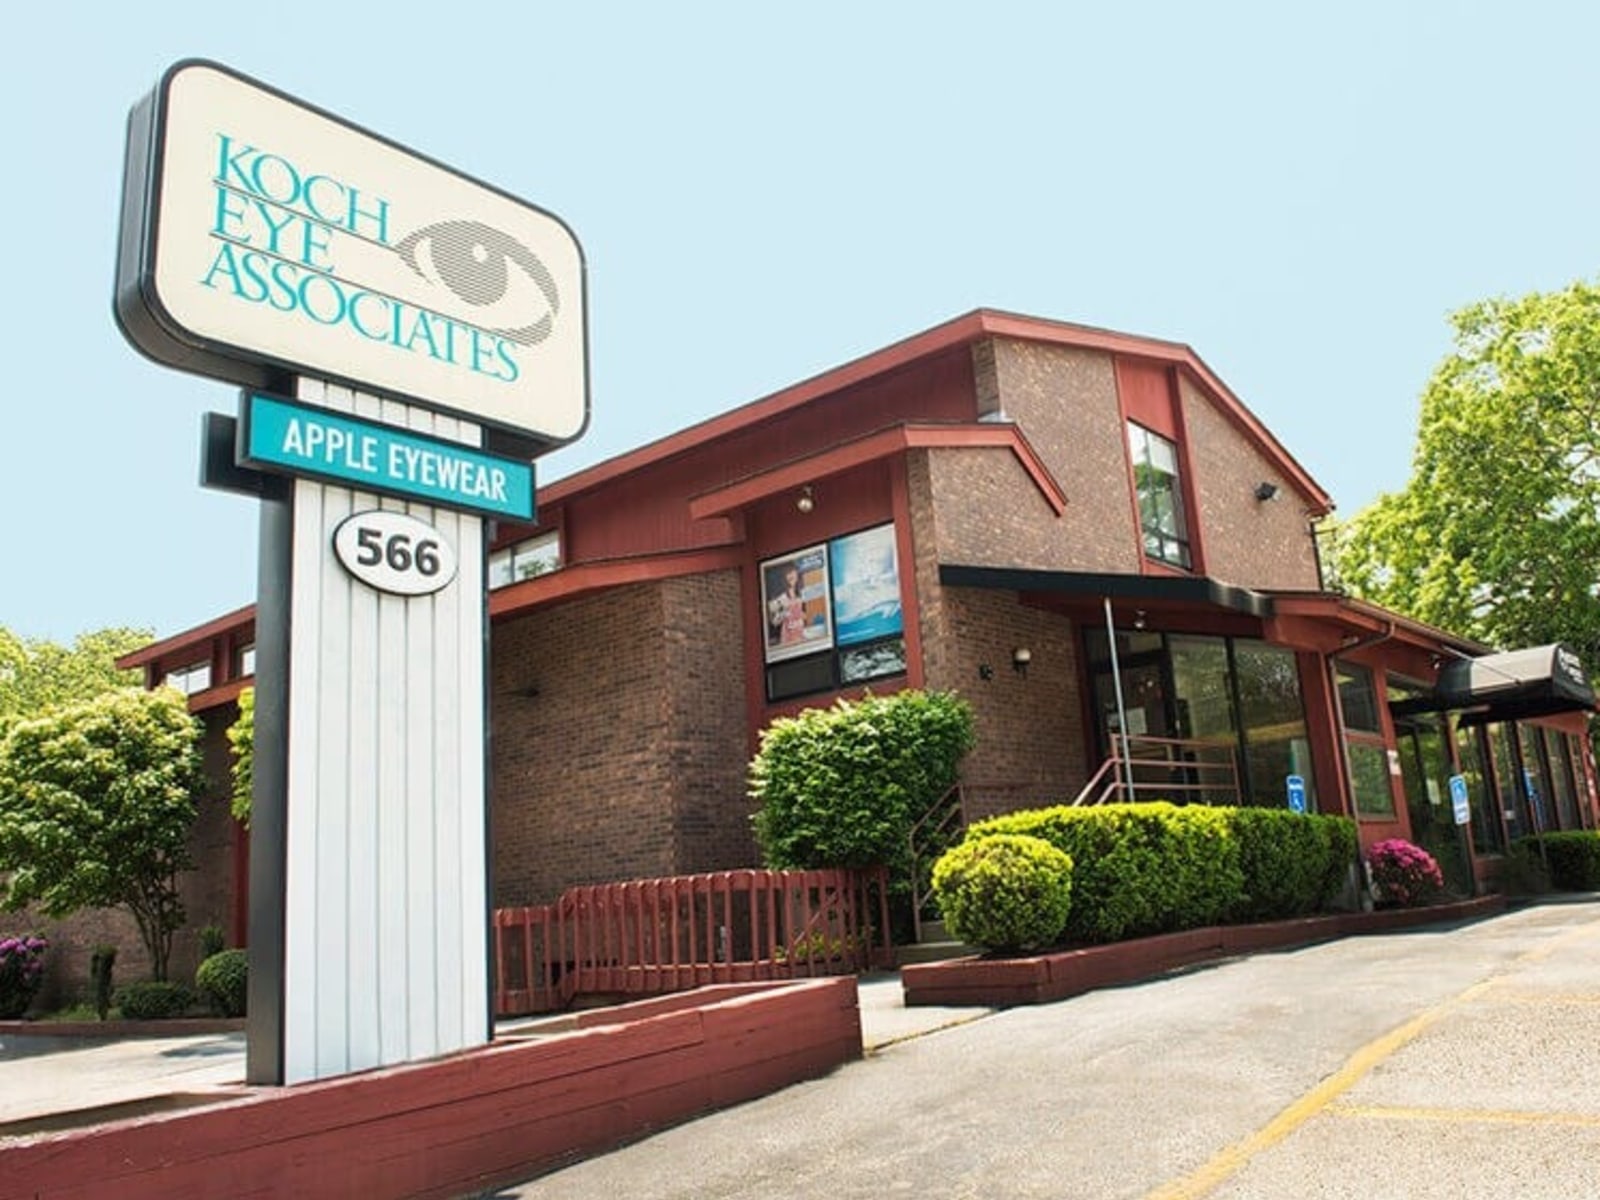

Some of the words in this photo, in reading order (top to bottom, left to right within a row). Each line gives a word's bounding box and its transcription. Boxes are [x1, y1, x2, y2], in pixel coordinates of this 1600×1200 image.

[213, 187, 335, 273] EYE
[214, 134, 390, 243] KOCH
[201, 244, 519, 383] ASSOCIATES
[283, 419, 377, 472] APPLE
[389, 445, 507, 501] EYEWEAR
[356, 528, 440, 576] 566
